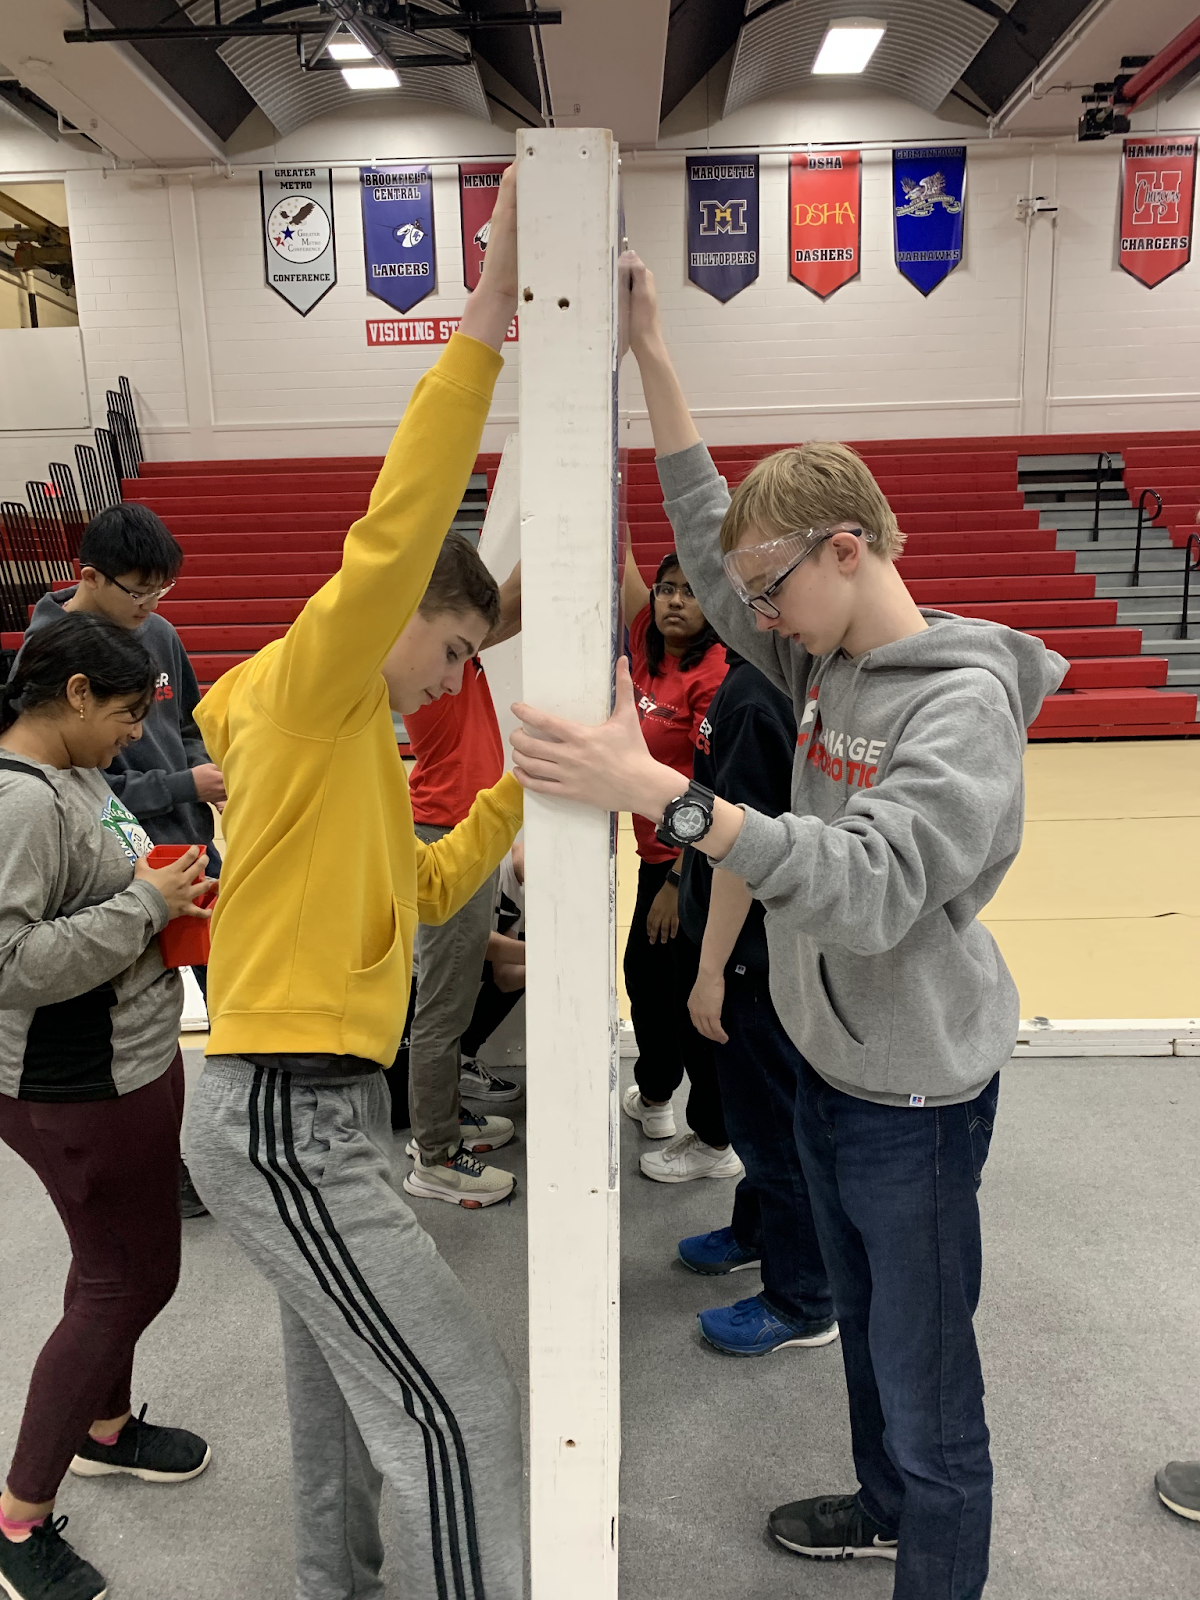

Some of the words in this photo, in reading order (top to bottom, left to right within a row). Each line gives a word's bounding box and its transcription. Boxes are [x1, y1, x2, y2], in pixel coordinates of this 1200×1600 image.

[895, 148, 962, 159] GERMANTOWN
[1127, 144, 1193, 158] HAMILTON
[808, 157, 842, 170] DSHA
[274, 168, 316, 177] GREATER
[364, 172, 427, 187] BROOKFIELD
[691, 165, 754, 181] MARQUETTE
[280, 181, 312, 190] METRO
[464, 174, 503, 188] MENOM
[373, 187, 421, 201] CENTRAL
[794, 202, 855, 226] DSHA
[1121, 237, 1188, 251] CHARGERS
[691, 251, 756, 266] HILLTOPPERS
[794, 248, 853, 262] DASHERS
[372, 263, 429, 277] LANCERS
[273, 273, 331, 282] CONFERENCE
[368, 322, 435, 342] VISITING
[806, 742, 878, 789] ROBOTIC
